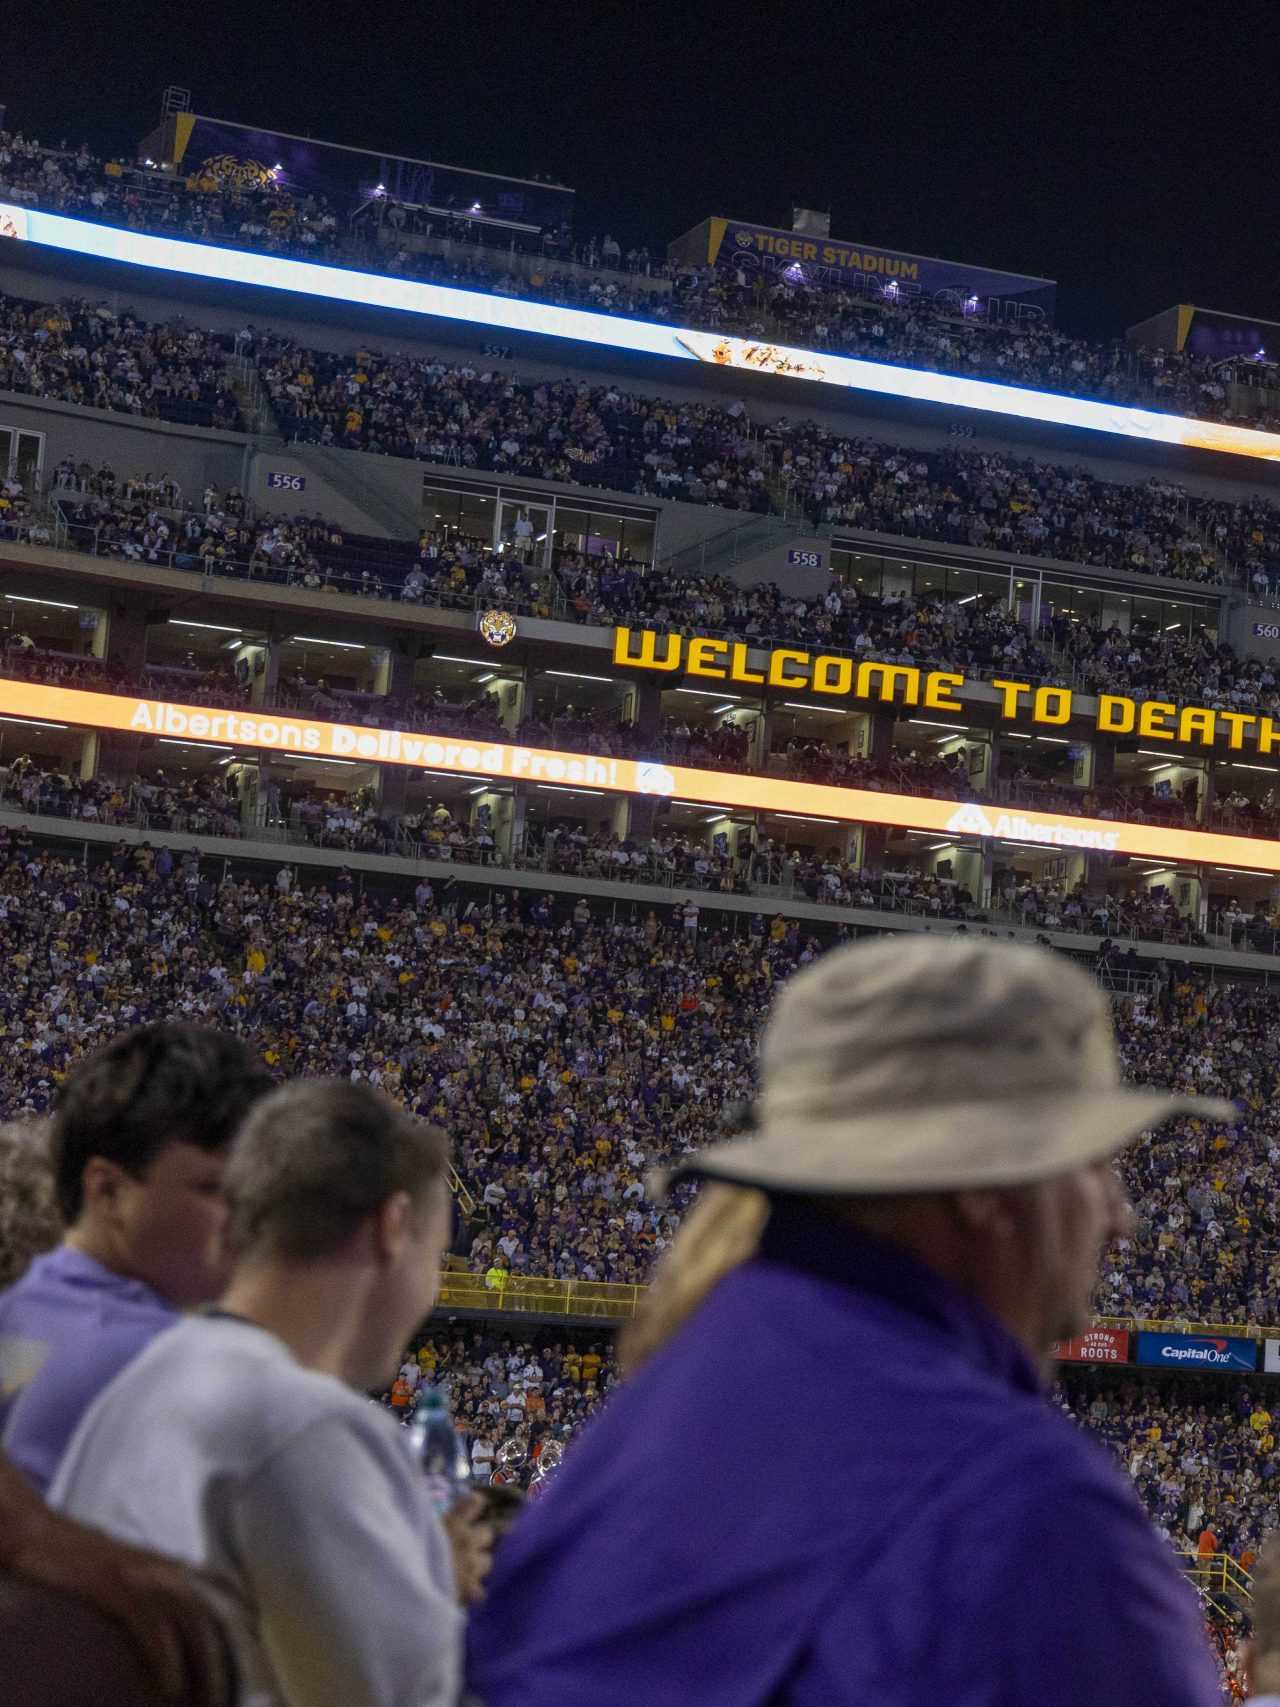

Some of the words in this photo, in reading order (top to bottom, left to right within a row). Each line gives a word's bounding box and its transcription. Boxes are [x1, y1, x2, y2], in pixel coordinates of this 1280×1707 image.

[756, 234, 816, 261] TIGER
[822, 249, 918, 279] STADIUM
[273, 474, 301, 490] 556
[792, 551, 818, 567] 558
[1256, 624, 1279, 639] 560
[612, 626, 965, 711] WELCOME
[992, 679, 1073, 725] TO
[131, 702, 320, 750] Albertsons
[332, 725, 504, 774] Delivered
[511, 747, 617, 786] Fresh!
[995, 815, 1119, 851] Albertsons
[1084, 1332, 1116, 1344] STRONG
[1080, 1347, 1118, 1360] ROOTS
